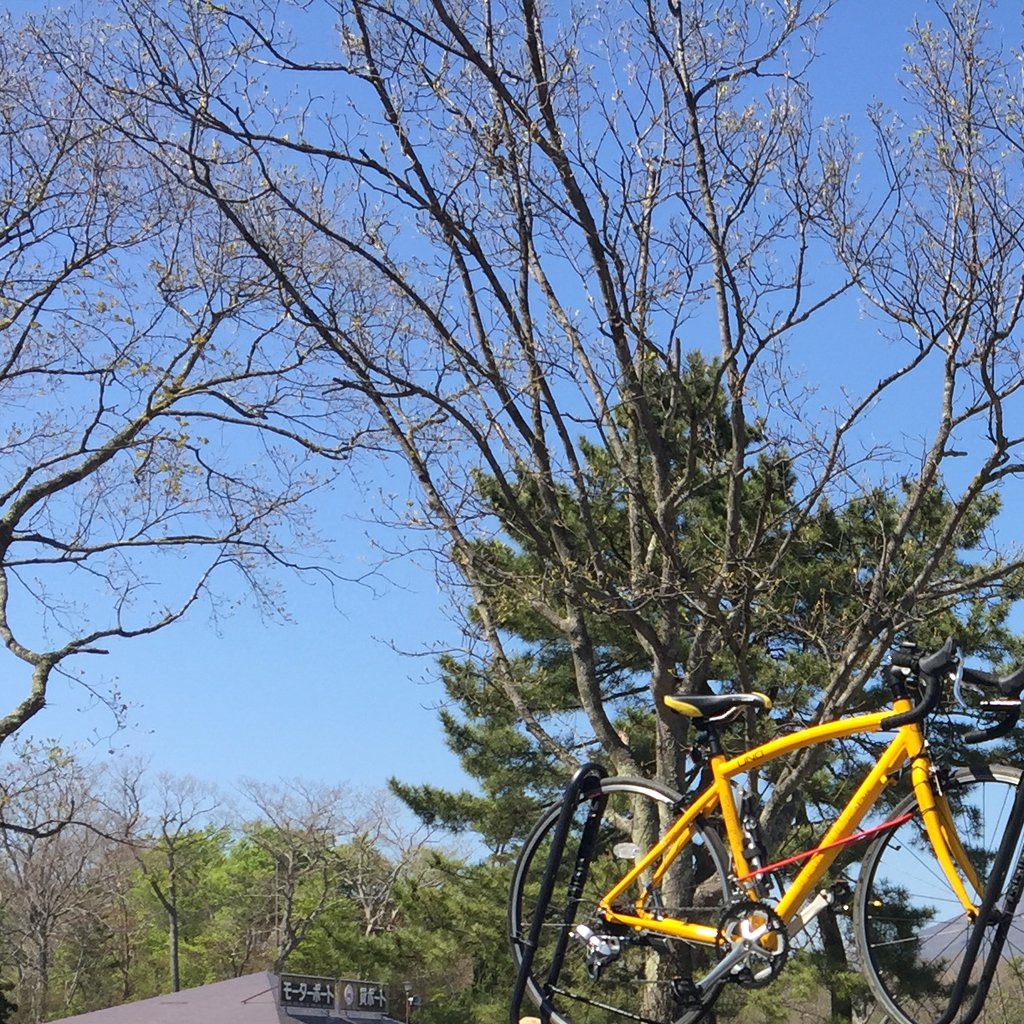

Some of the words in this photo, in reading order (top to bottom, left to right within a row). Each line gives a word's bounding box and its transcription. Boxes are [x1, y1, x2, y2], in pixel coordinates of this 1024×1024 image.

[283, 981, 335, 1004] モーターボート
